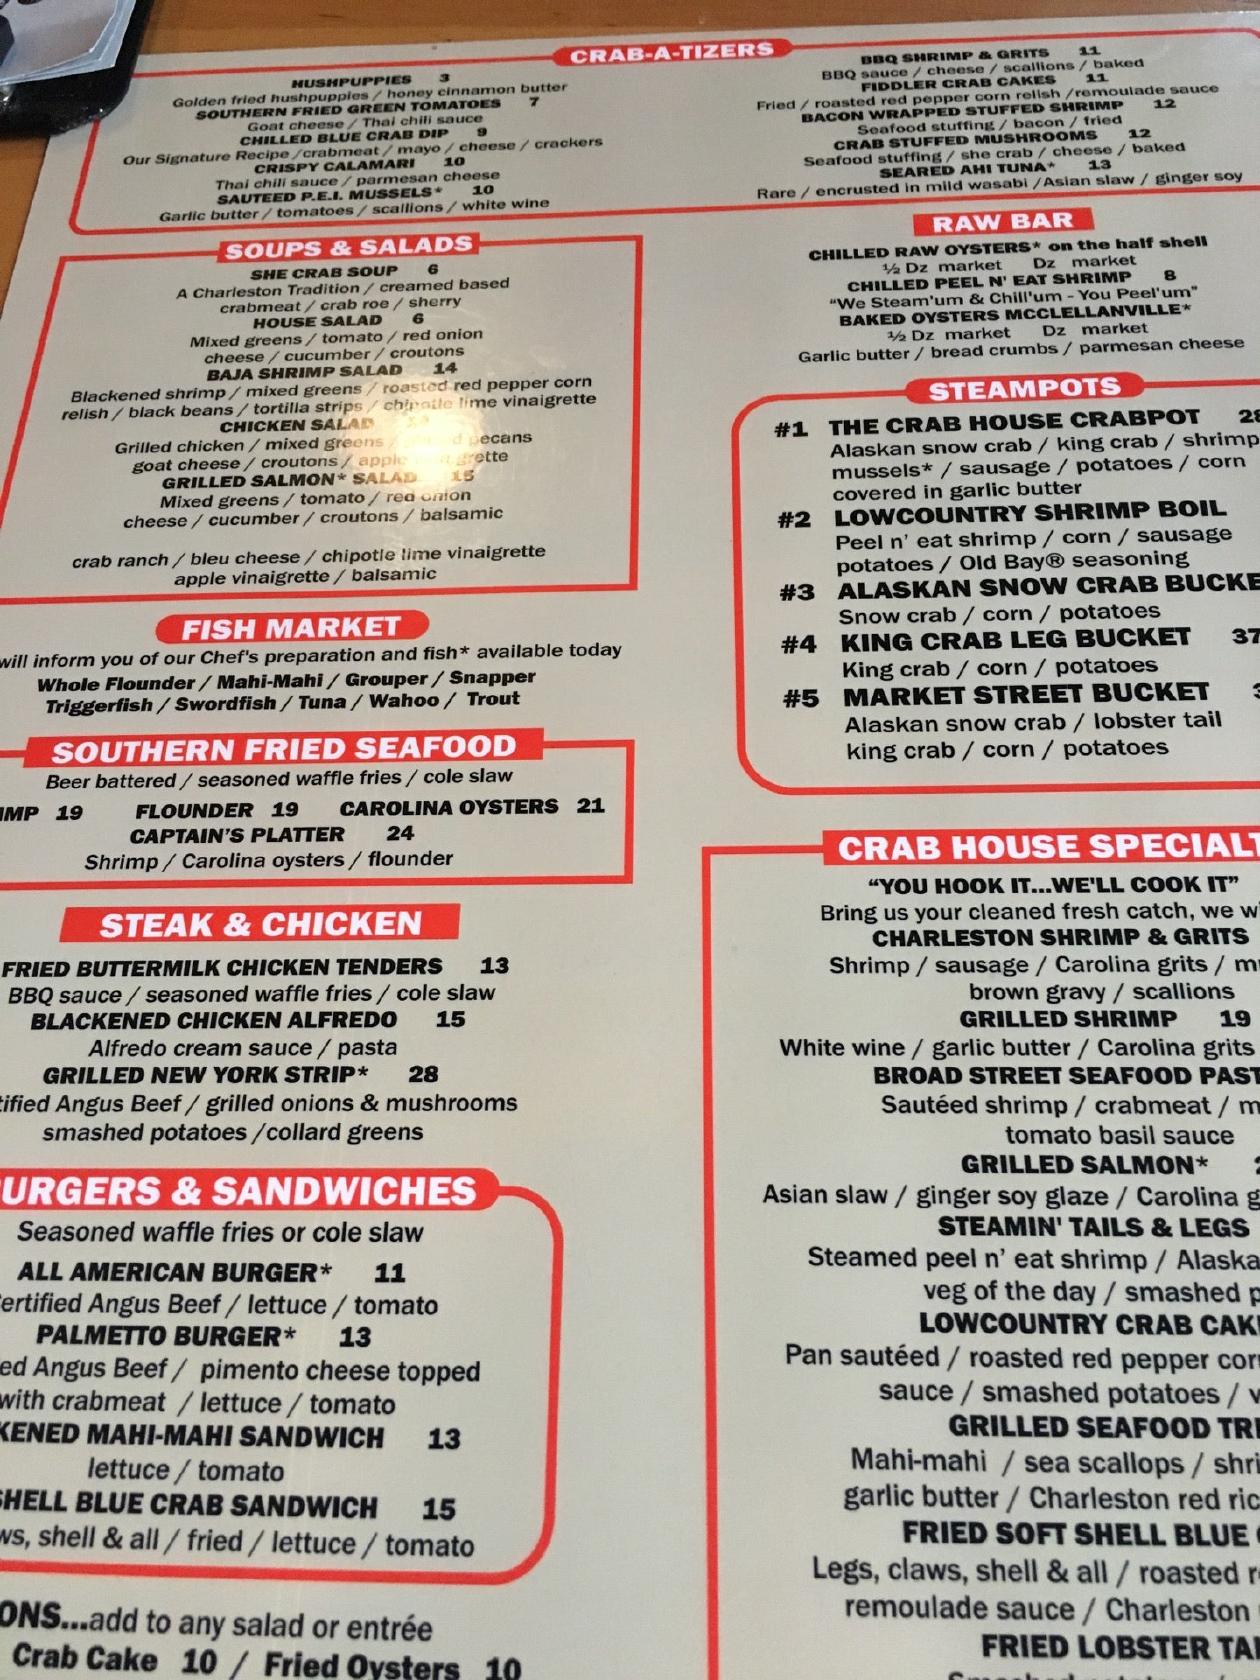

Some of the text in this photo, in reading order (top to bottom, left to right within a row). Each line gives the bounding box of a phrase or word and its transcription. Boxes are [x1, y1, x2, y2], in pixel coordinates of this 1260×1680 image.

[570, 42, 775, 64] CRAB-A-TIZERS
[861, 46, 1101, 65] BBQ SHRIMP & GRITS 11
[292, 74, 449, 88] HUSHPUPPIES 3
[861, 73, 1108, 92] FIDDLER CRAB CAKES 11
[196, 97, 539, 120] SOUTHERN FRIED GREEN TOMATOES 7
[802, 99, 1176, 123] BACON WRAPPED STUFFED SHRIMP 12
[858, 123, 926, 135] Seafood
[932, 121, 995, 131] stuffing
[1014, 119, 1064, 128] bacon
[1084, 115, 1122, 125] fried
[240, 128, 487, 146] CHILLED BLUE CRAB DIP 9
[834, 129, 1151, 150] CRAB STUFFED MUSHROOMS 12
[254, 157, 465, 174] CRISPY CALAMARI 10
[216, 179, 248, 190] Thai
[254, 178, 285, 189] chili
[291, 178, 338, 187] sauce
[357, 174, 437, 187] parmesan
[444, 172, 500, 181] cheese
[934, 213, 1072, 232] RAW BAR
[226, 236, 472, 259] SOUPS & SALADS
[250, 264, 438, 280] SHE CRAB SOUP 6
[848, 279, 929, 292] CHILLED
[935, 277, 984, 289] PEEL
[1013, 274, 1047, 286] EAT
[1053, 271, 1131, 284] SHRIMP
[1164, 270, 1176, 281] 8
[176, 289, 187, 299] A
[193, 287, 282, 298] Charleston
[288, 283, 359, 295] Tradition
[380, 280, 453, 292] creamed
[459, 277, 509, 289] based
[253, 313, 424, 329] HOUSE SALAD 6
[799, 350, 850, 363] Garlic
[857, 349, 909, 361] butter
[931, 345, 983, 358] bread
[989, 343, 1058, 356] crumbs
[1080, 341, 1173, 355] parmesan
[1179, 338, 1244, 350] cheese
[207, 362, 457, 381] BAJA SHRIMP SALAD 14
[930, 378, 1120, 401] STEAMPOTS
[833, 481, 1082, 501] covered in garlic butter
[777, 500, 1227, 528] #2 LOWCOUNTRY SHRIMP BOIL
[183, 616, 401, 640] FISH MARKET
[52, 735, 516, 763] SOUTHERN FRIED SEAFOOD
[251, 827, 345, 843] PLATTER
[387, 825, 415, 841] 24
[101, 912, 421, 938] STEAK & CHICKEN
[872, 928, 1249, 947] CHARLESTON SHRIMP & GRITS
[1, 957, 509, 977] FRIED BUTTERMILK CHICKEN TENDERS 13
[31, 1011, 465, 1030] BLACKENED CHICKEN ALFREDO 15
[960, 1010, 1251, 1028] GRILLED SHRIMP 19
[1005, 1125, 1234, 1145] tomato basil sauce
[17, 1221, 424, 1242] Seasoned waffle fries or cole slaw
[1069, 1217, 1144, 1237] TAILS
[1151, 1217, 1173, 1237] &
[1179, 1218, 1250, 1238] LEGS
[88, 1457, 170, 1480] lettuce
[199, 1460, 284, 1482] tomato
[846, 1595, 988, 1619] remoulade
[997, 1601, 1074, 1621] sauce
[1106, 1597, 1250, 1621] Charleston
[146, 1610, 171, 1634] to
[179, 1615, 226, 1641] any
[232, 1612, 304, 1638] salad
[312, 1619, 339, 1639] or
[347, 1614, 433, 1642] entrée
[13, 1642, 78, 1669] Crab
[87, 1645, 158, 1672] Cake
[182, 1648, 217, 1675] 10
[264, 1651, 339, 1678] Fried
[347, 1654, 460, 1680] Oysters
[486, 1657, 521, 1680] 10
